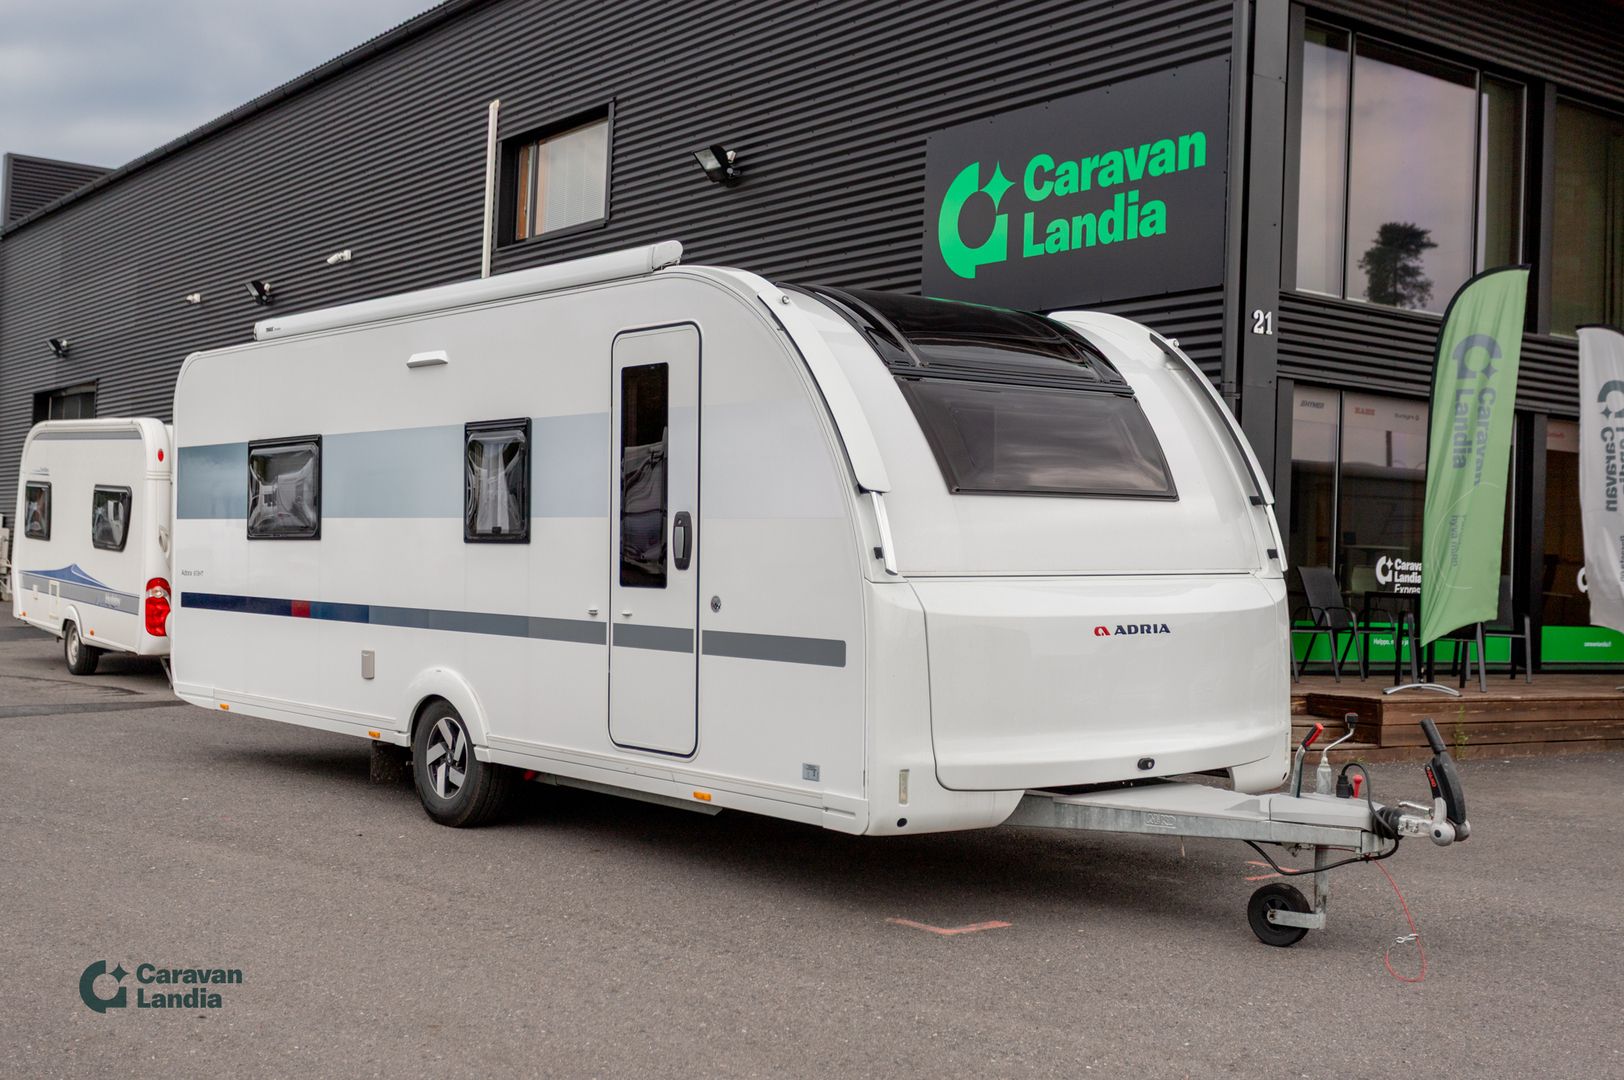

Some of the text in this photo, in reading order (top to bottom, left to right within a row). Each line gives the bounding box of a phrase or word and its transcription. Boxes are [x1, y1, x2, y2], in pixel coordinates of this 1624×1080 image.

[1023, 131, 1206, 202] Caravan
[1023, 189, 1167, 258] Landia
[1252, 309, 1273, 335] 21
[1453, 389, 1474, 469] Landia
[1474, 387, 1497, 487] Caravan
[1394, 558, 1422, 571] Carava
[1394, 570, 1422, 583] Landia
[1114, 623, 1171, 636] ADRIA
